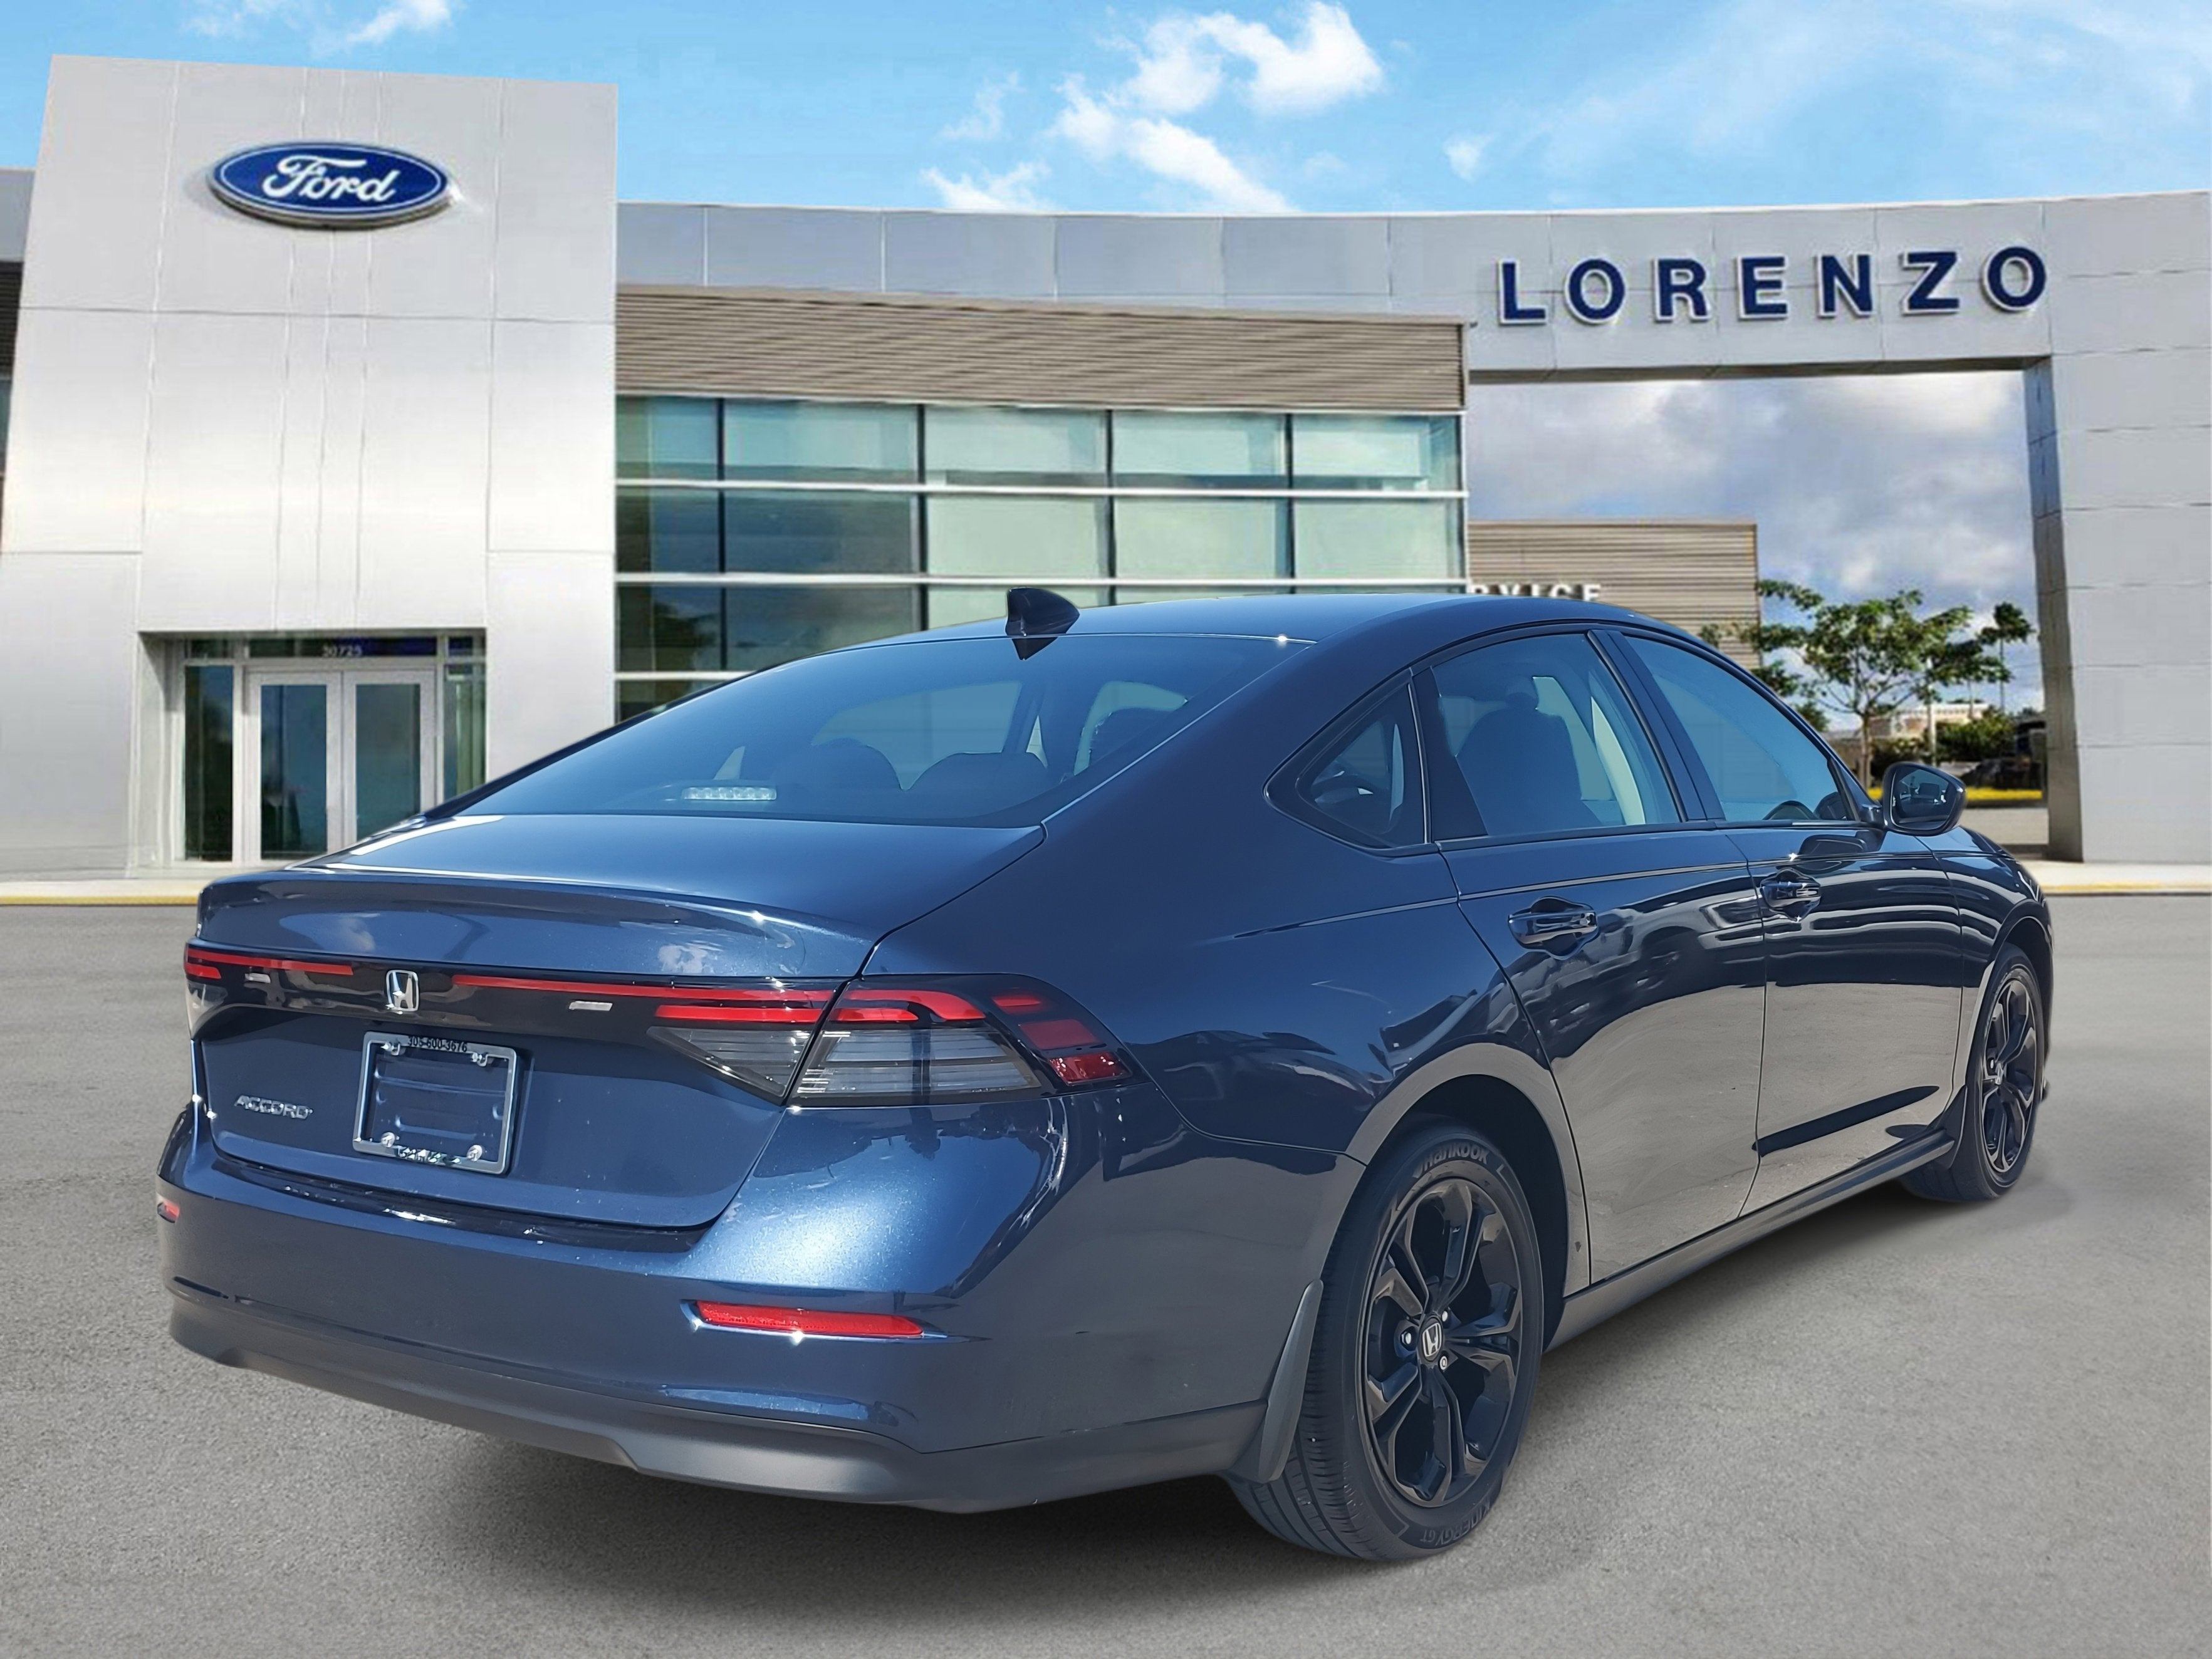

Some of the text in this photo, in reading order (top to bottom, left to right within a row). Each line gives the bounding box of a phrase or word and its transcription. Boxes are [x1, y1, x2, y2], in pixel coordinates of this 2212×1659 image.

[262, 154, 401, 202] Ford
[1498, 246, 2047, 325] LORENZO
[234, 1095, 310, 1119] ACCORD
